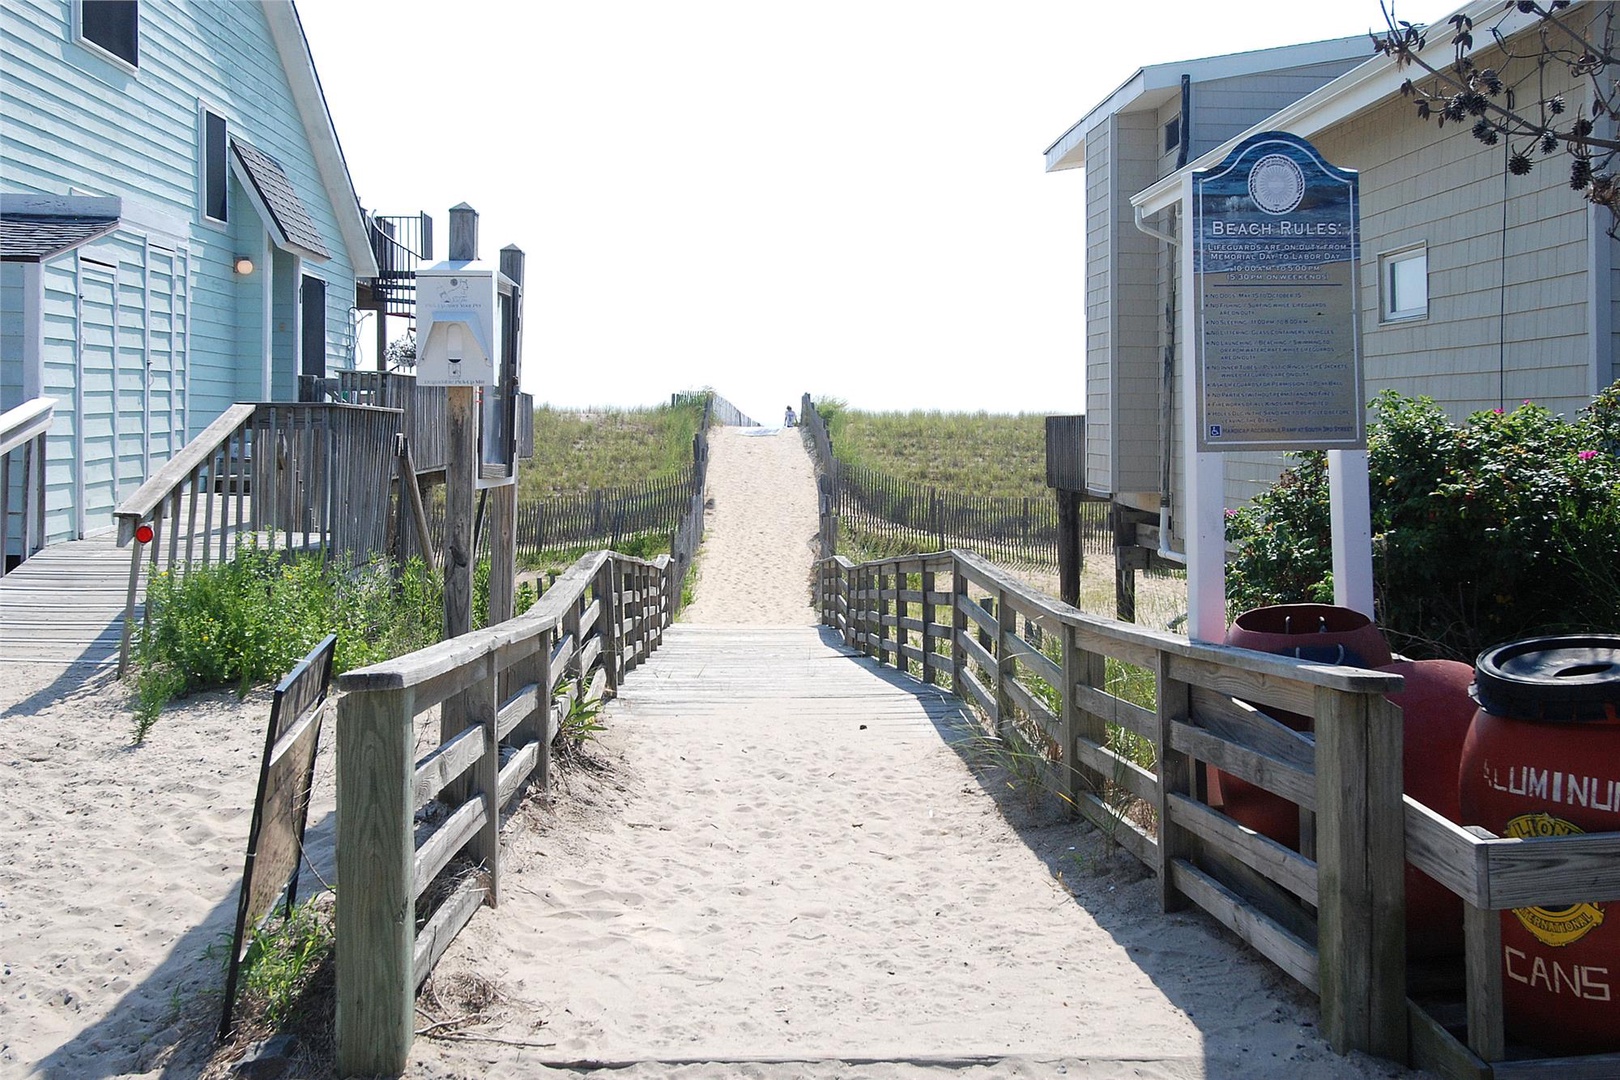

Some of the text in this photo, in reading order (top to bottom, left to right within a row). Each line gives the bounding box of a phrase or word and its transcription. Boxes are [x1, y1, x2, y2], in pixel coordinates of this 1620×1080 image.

[1212, 221, 1343, 235] BEACH RULES:
[1505, 945, 1611, 1001] CANS
